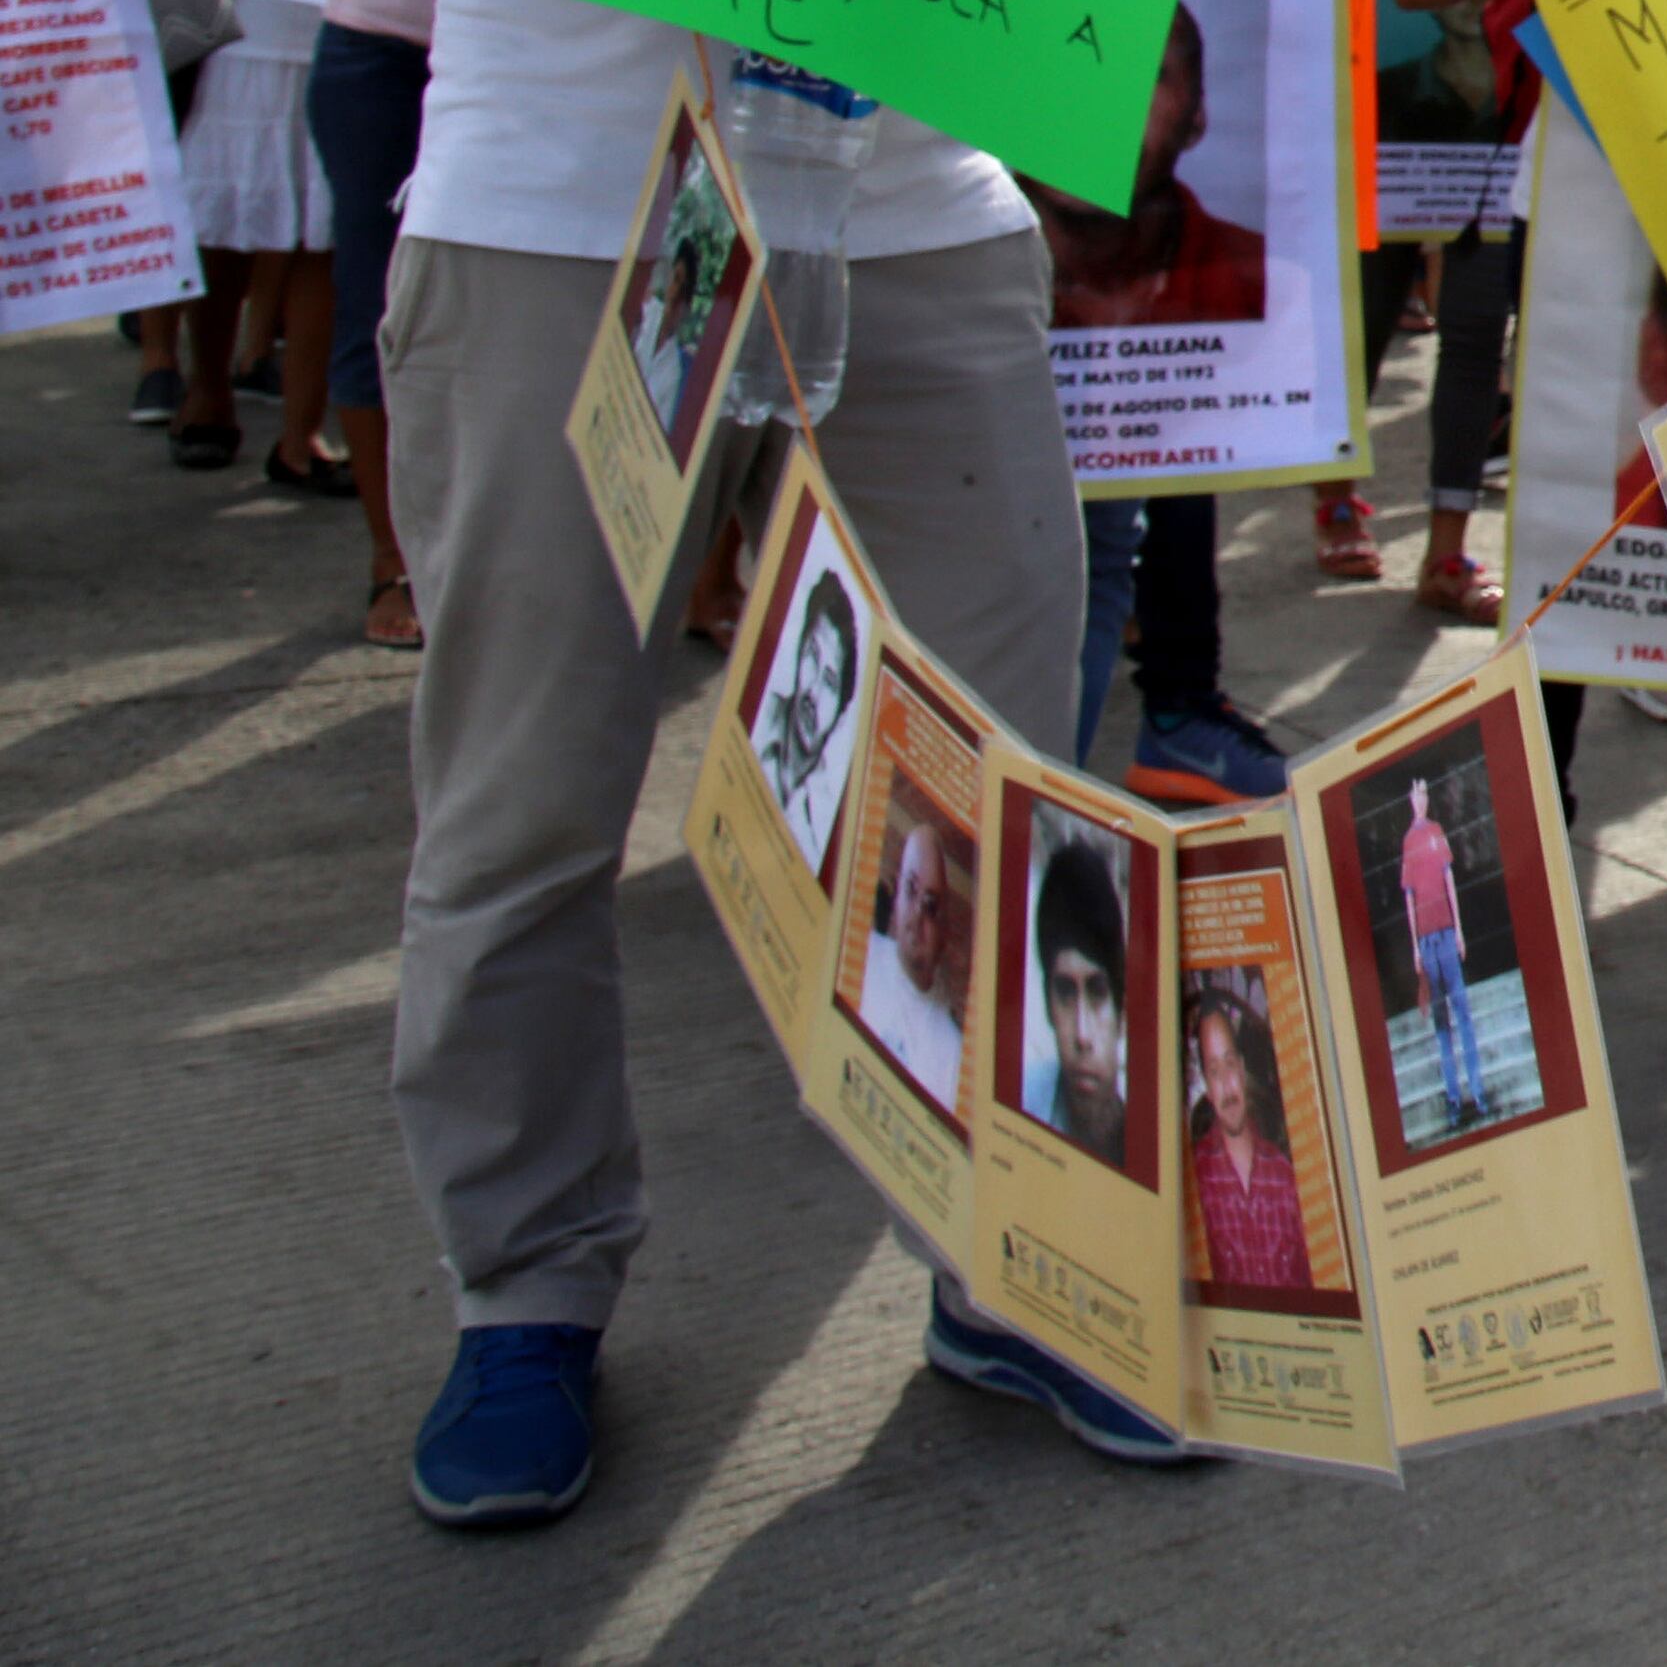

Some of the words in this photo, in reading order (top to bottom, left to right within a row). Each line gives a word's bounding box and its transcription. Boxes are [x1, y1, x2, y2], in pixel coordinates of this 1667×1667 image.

[1066, 14, 1103, 64] A
[1118, 336, 1225, 359] GALEANA
[1082, 369, 1140, 385] MAYO
[1111, 396, 1186, 416] AGOSTO
[1190, 396, 1221, 411] DEL
